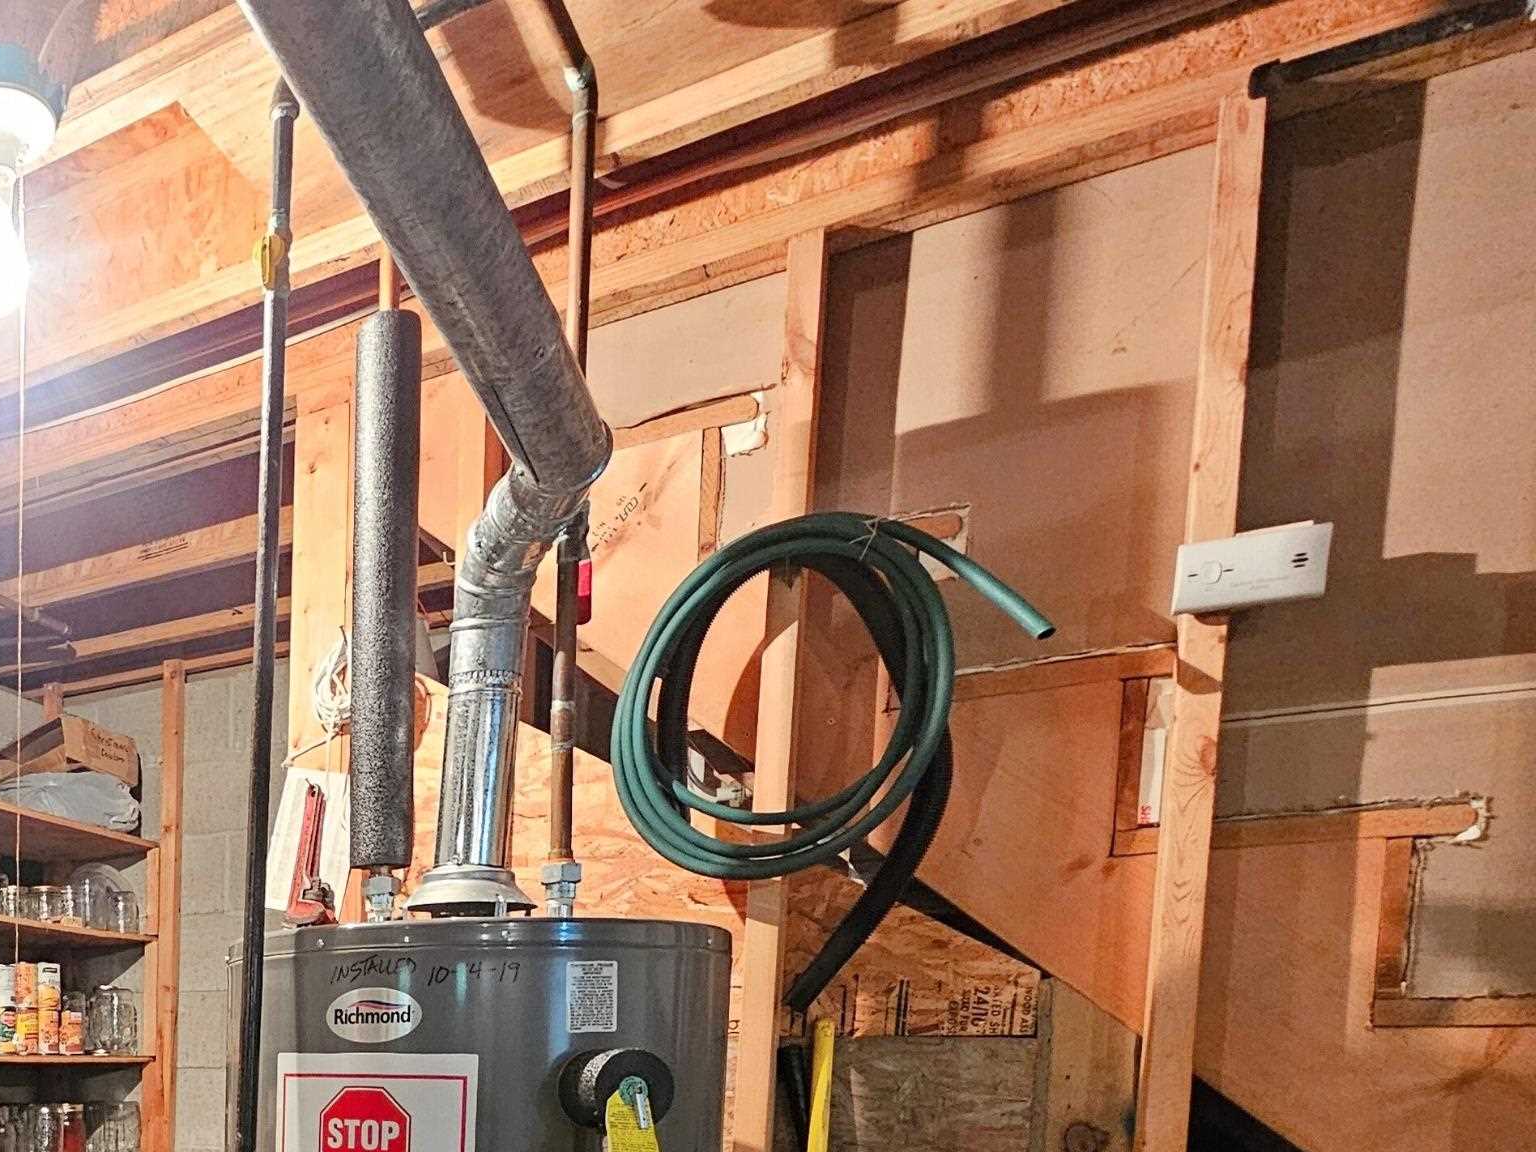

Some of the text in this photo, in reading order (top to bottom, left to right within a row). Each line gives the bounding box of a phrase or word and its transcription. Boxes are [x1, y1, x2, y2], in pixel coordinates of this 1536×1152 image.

[330, 954, 521, 986] INSTALLED 10-4-19
[334, 1005, 411, 1025] Richmond
[327, 1117, 400, 1151] STOP
